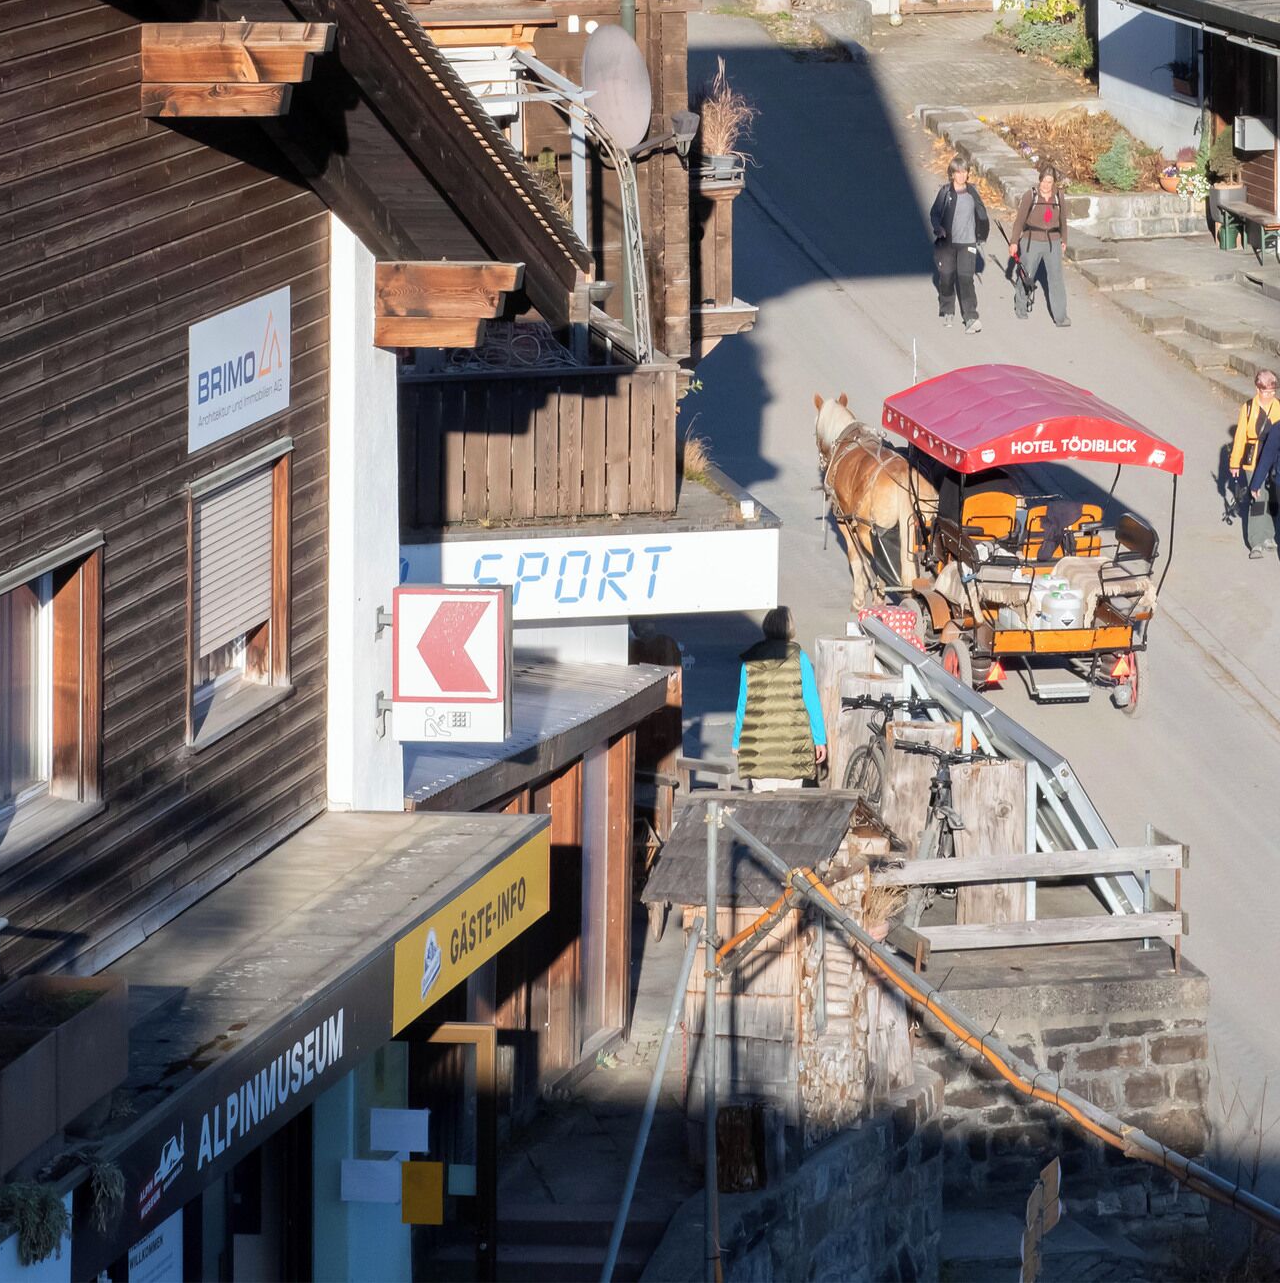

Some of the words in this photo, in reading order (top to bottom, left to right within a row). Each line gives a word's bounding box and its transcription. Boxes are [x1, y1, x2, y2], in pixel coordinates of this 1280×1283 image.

[197, 350, 255, 405] BRIMO
[1011, 440, 1057, 455] HOTEL
[1061, 435, 1136, 453] TÖDIBLICK
[473, 545, 672, 605] SPORT
[450, 876, 526, 965] GÄSTE-INFO
[197, 1007, 344, 1171] ALPINMUSEUM
[129, 1235, 164, 1270] WILLKOMMEN
